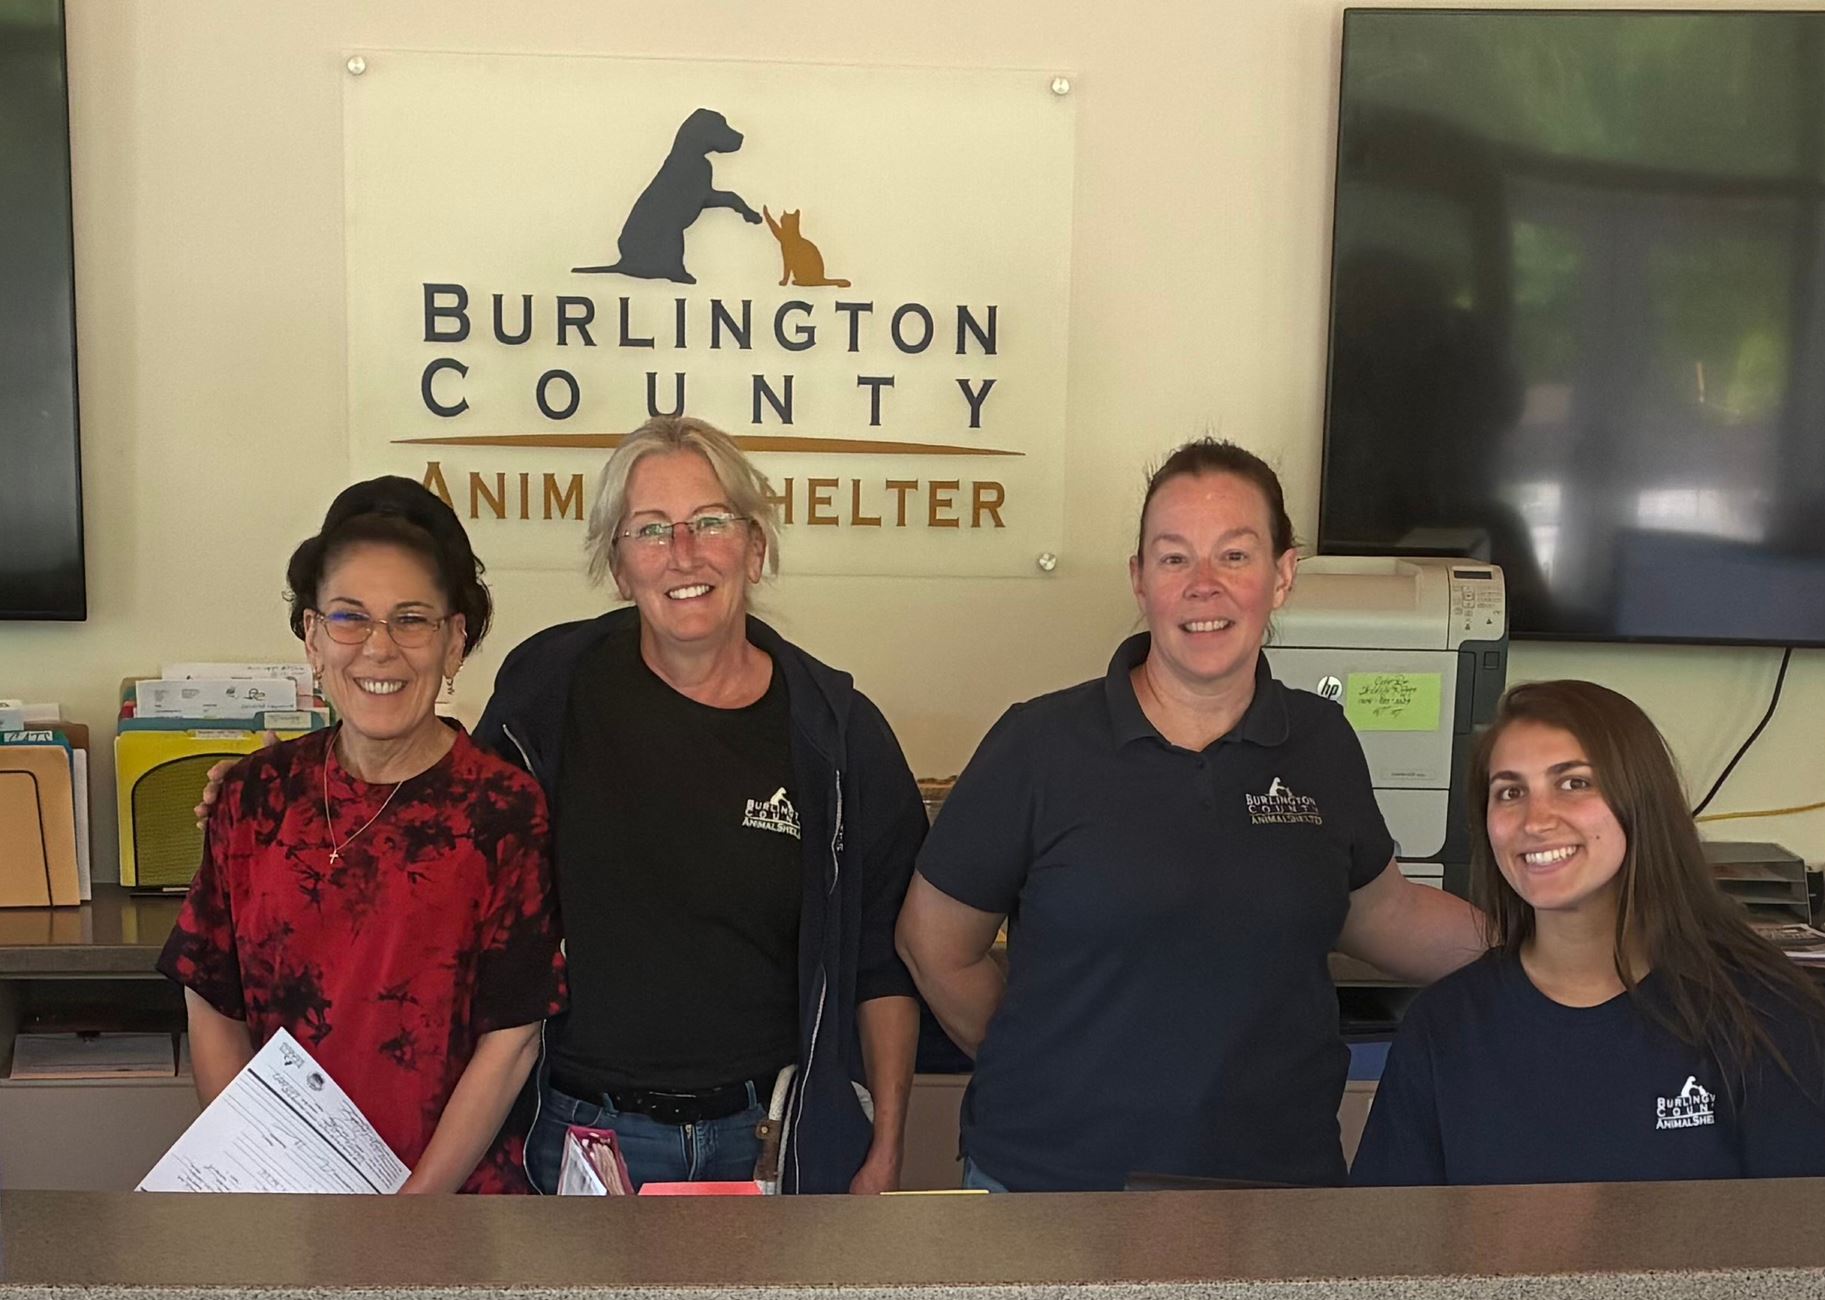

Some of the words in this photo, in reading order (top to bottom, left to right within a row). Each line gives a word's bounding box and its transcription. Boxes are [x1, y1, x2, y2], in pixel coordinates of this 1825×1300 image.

[422, 283, 998, 355] BURLINGTON
[420, 358, 997, 428] COUNTY
[421, 462, 585, 521] ANIM
[766, 477, 1007, 529] HELTER
[1321, 676, 1340, 700] hp
